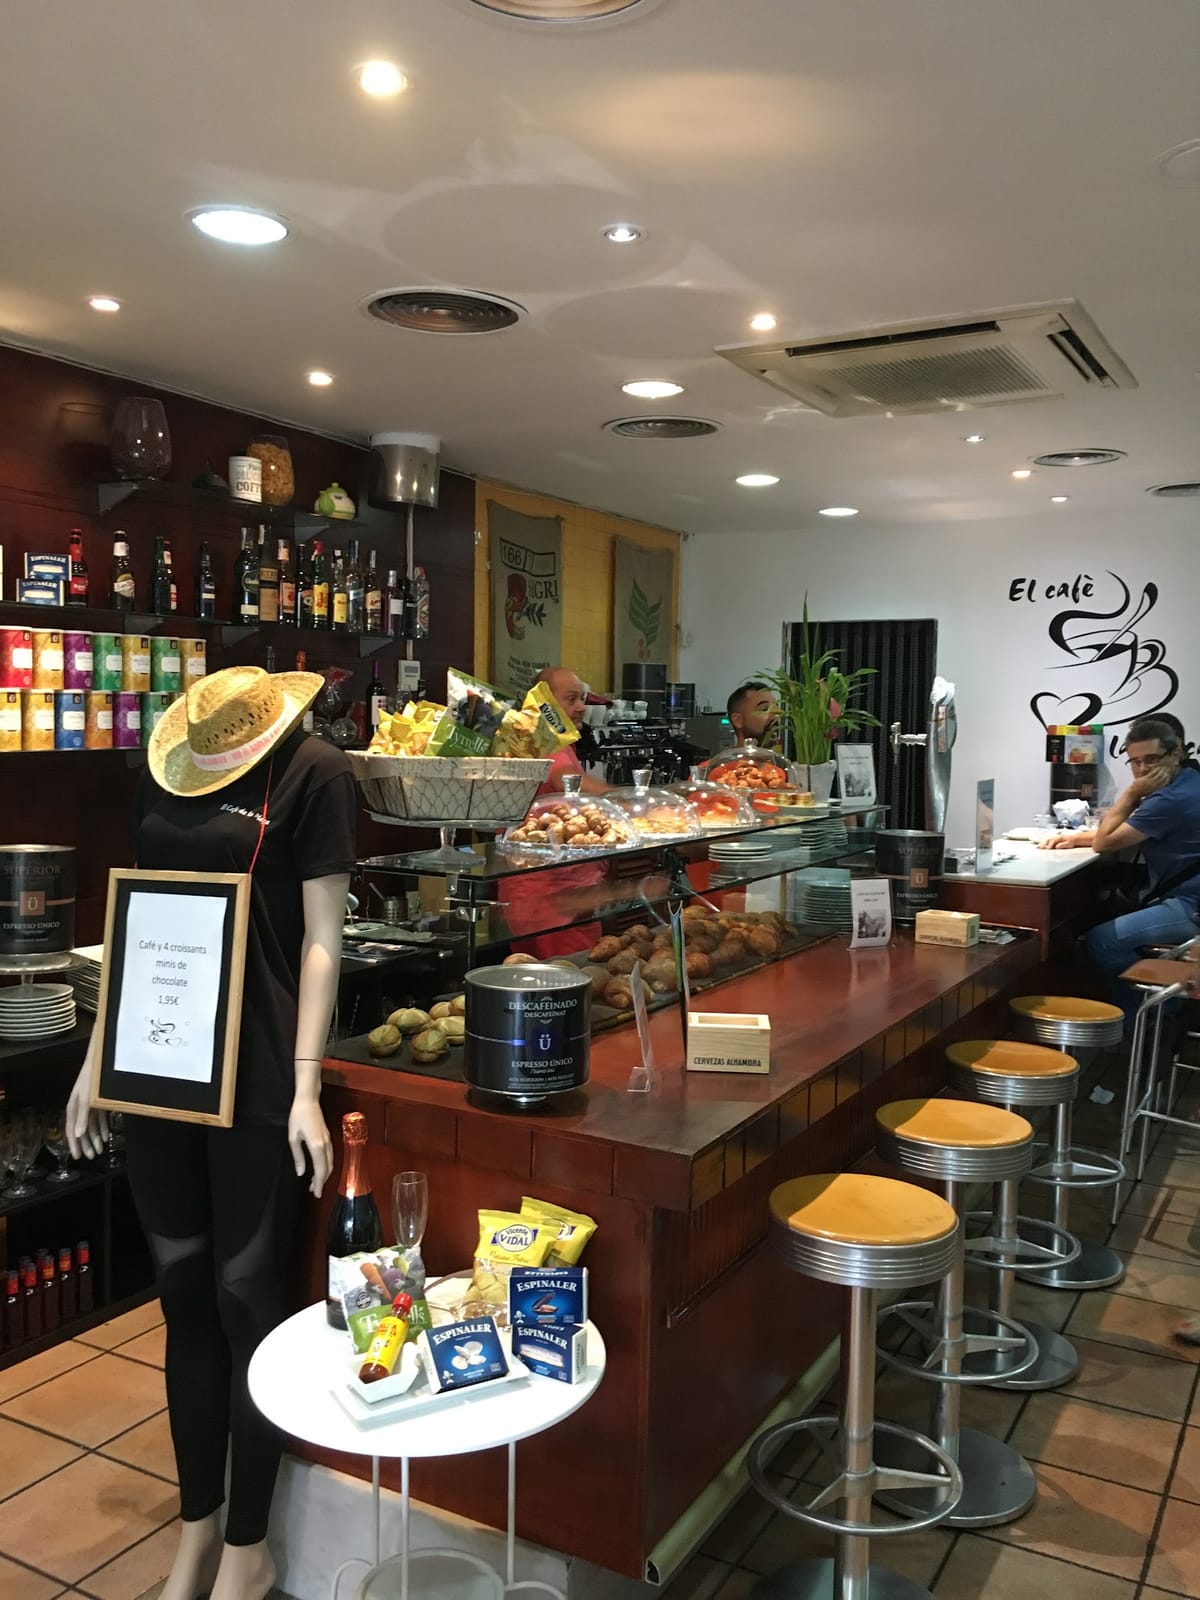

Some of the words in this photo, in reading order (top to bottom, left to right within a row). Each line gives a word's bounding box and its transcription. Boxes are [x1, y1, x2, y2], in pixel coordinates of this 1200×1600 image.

[1009, 578, 1036, 602] El
[1045, 574, 1095, 604] cafè
[27, 896, 39, 911] Ü
[138, 939, 156, 951] Café
[156, 944, 162, 952] y
[162, 942, 169, 950] 4
[169, 943, 207, 955] croissants
[155, 958, 176, 969] minis
[177, 960, 187, 970] de
[151, 974, 188, 987] chocolate
[157, 994, 180, 1006] 1,95€
[538, 1033, 552, 1051] Ü
[511, 1060, 549, 1068] ESPRESSO
[693, 1057, 725, 1066] CERVEZAS
[726, 1059, 762, 1067] ALHAMBRA
[500, 1234, 529, 1246] VIDAL
[516, 1279, 577, 1292] ESPINALER
[432, 1323, 492, 1346] ESPINALER
[517, 1327, 568, 1350] ESPINALER
